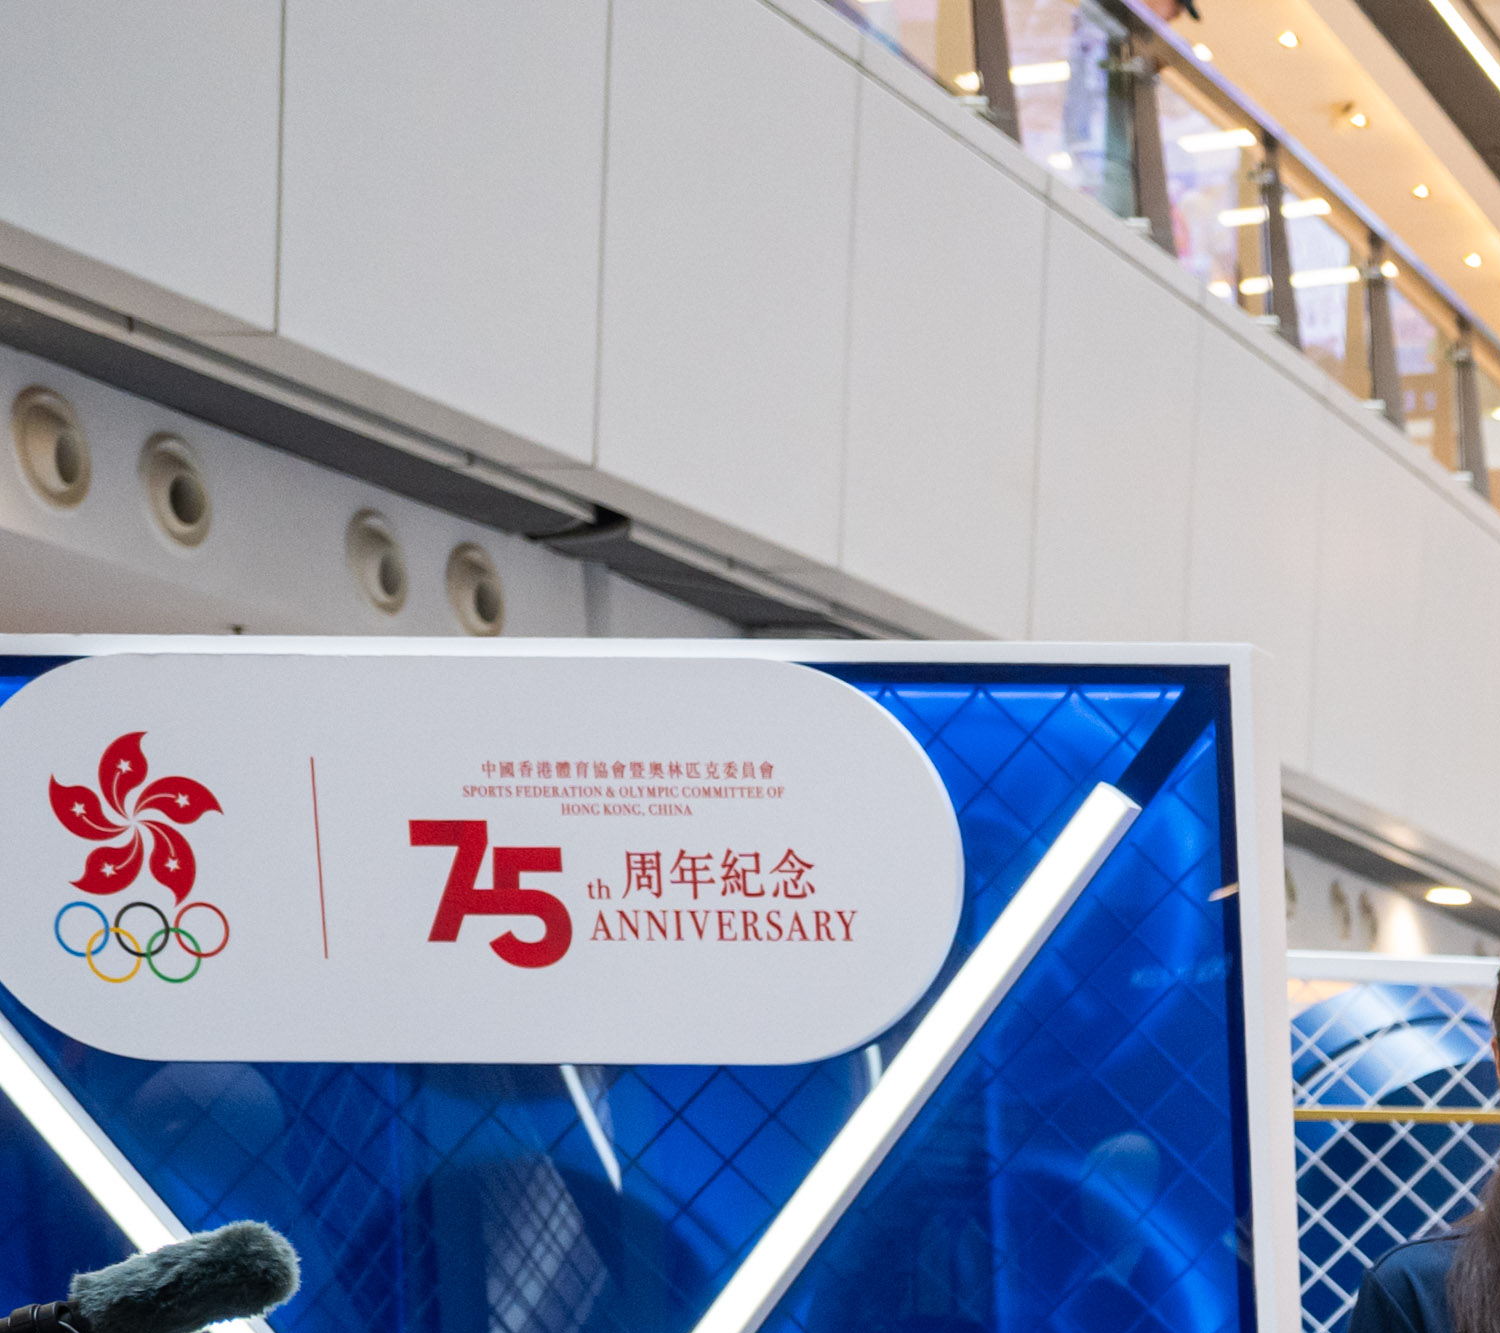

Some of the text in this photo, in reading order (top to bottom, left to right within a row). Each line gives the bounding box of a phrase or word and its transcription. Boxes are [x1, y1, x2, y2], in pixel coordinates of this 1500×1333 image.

[481, 760, 775, 780] 中國香港體育協會暨奧林匹克委員會
[462, 785, 785, 799] SPORTS FEDERATION & OLYMPIC COMMITTEE OF
[561, 803, 692, 817] HONG KONG, CHINA
[622, 848, 816, 901] 周年紀念
[408, 819, 573, 969] 75
[587, 878, 612, 900] th
[589, 910, 858, 942] ANNIVERSARY
